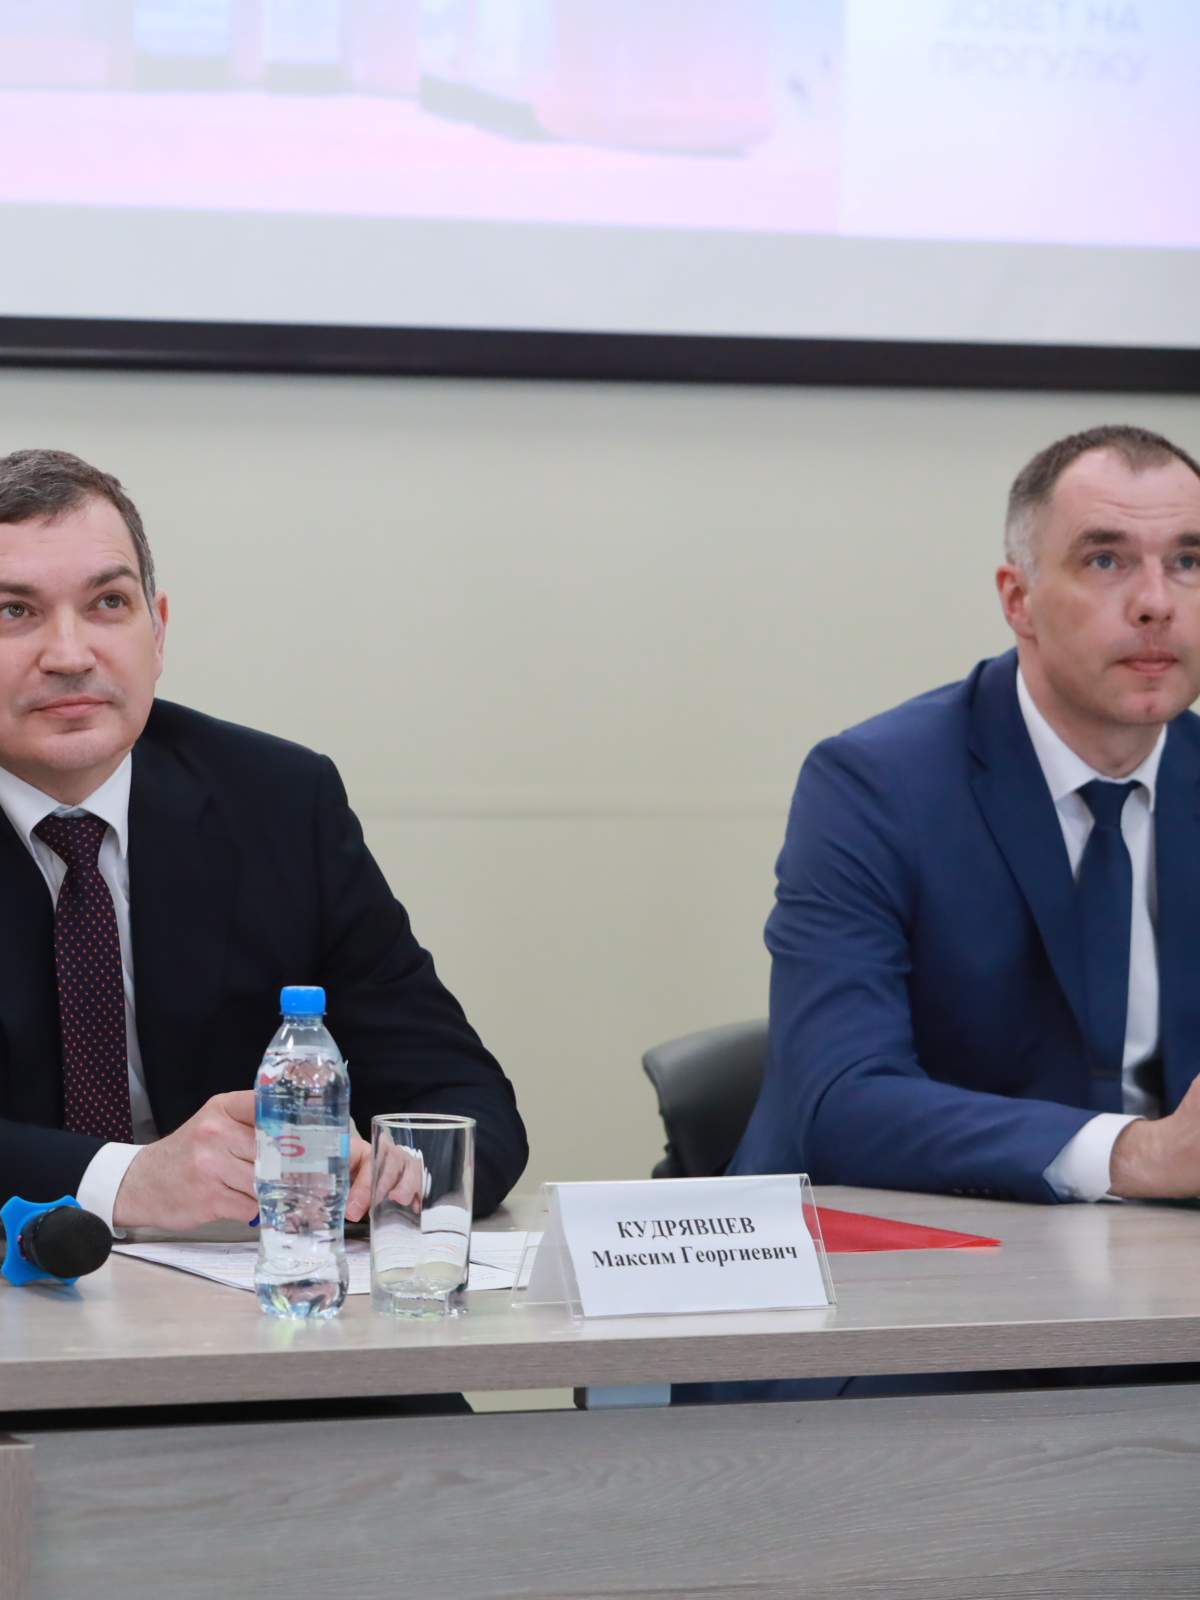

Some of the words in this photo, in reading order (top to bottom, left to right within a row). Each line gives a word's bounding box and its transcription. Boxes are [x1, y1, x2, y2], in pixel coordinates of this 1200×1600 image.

[1086, 0, 1145, 35] НА
[930, 40, 1152, 86] ПРОГУЛКУ
[616, 1217, 756, 1240] КУДРЯВЦЕВ
[591, 1249, 675, 1268] Максим
[680, 1245, 798, 1267] Георгиевич
